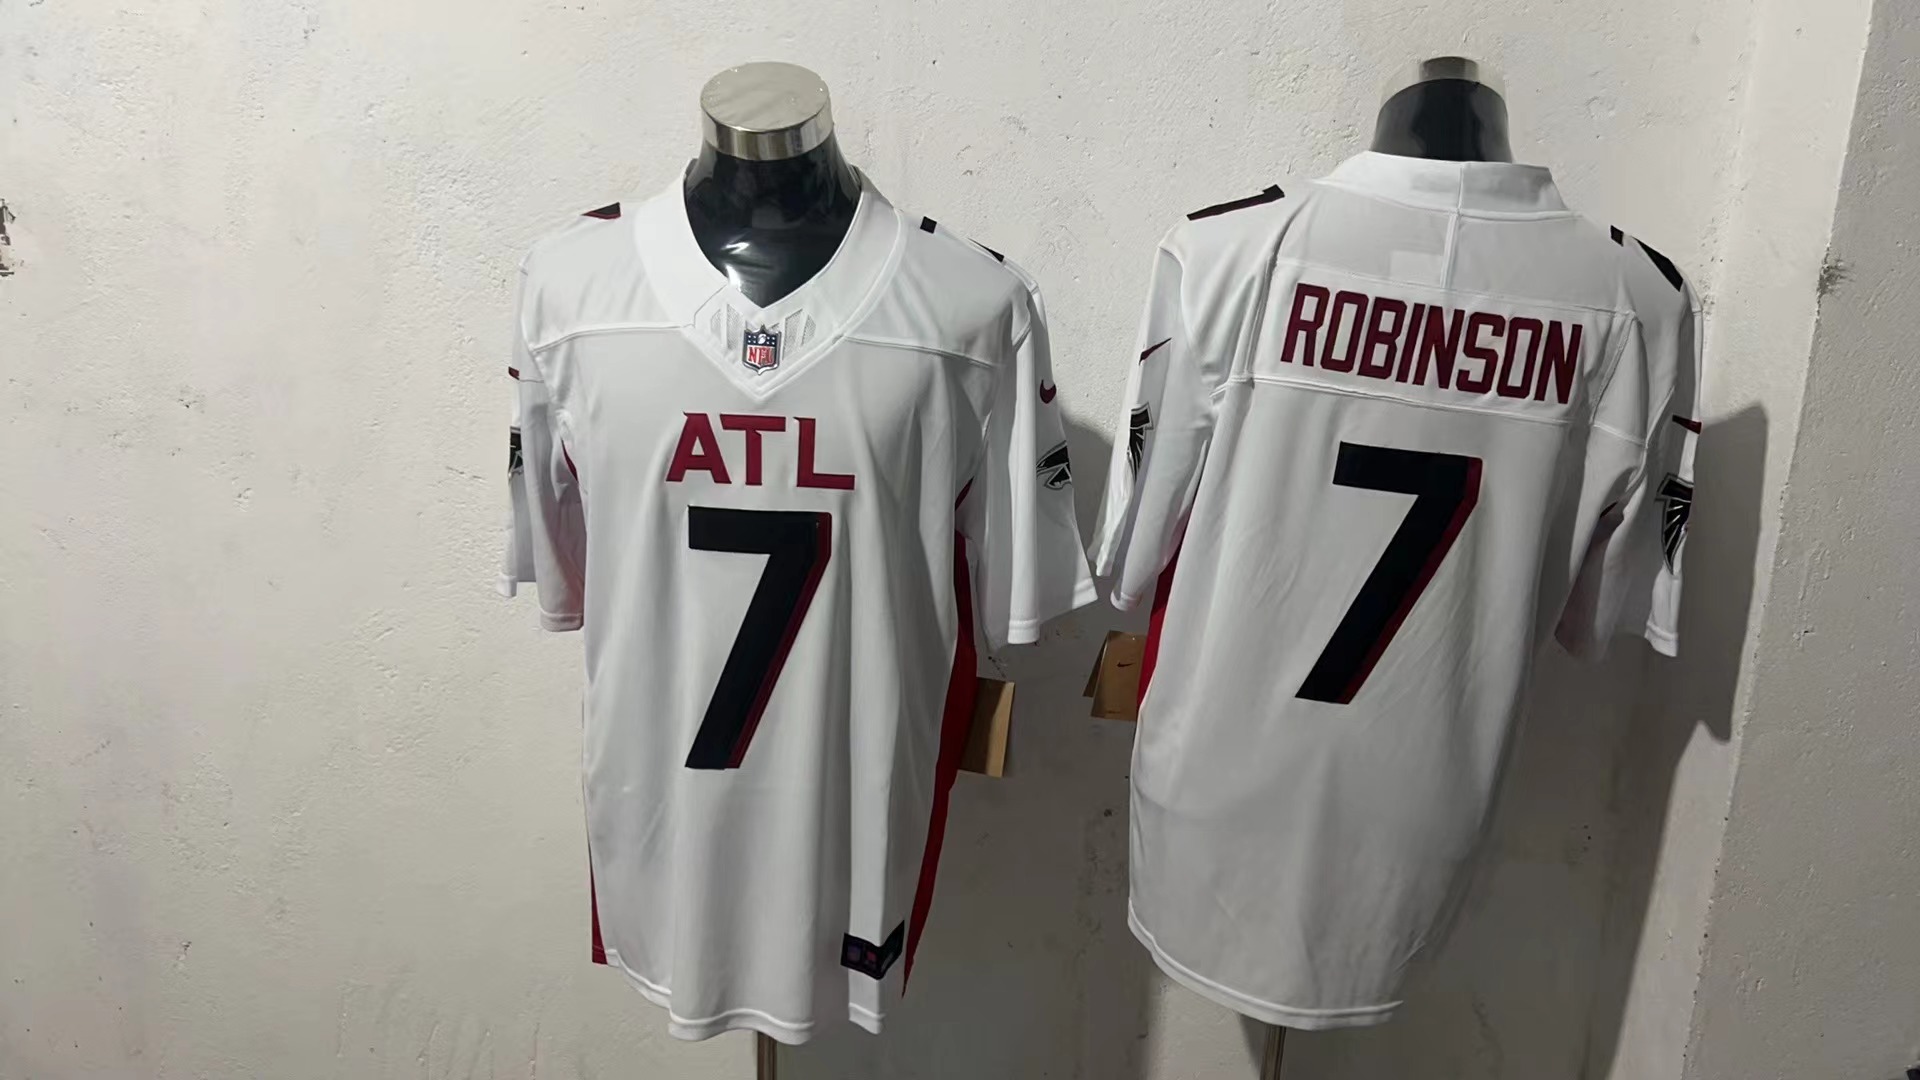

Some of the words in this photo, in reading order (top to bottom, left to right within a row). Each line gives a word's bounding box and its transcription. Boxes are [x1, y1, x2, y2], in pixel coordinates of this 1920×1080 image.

[748, 346, 775, 367] NFL
[1281, 283, 1583, 404] ROBINSON
[665, 411, 856, 491] ATL
[1295, 441, 1483, 704] 7
[684, 505, 832, 770] 7
